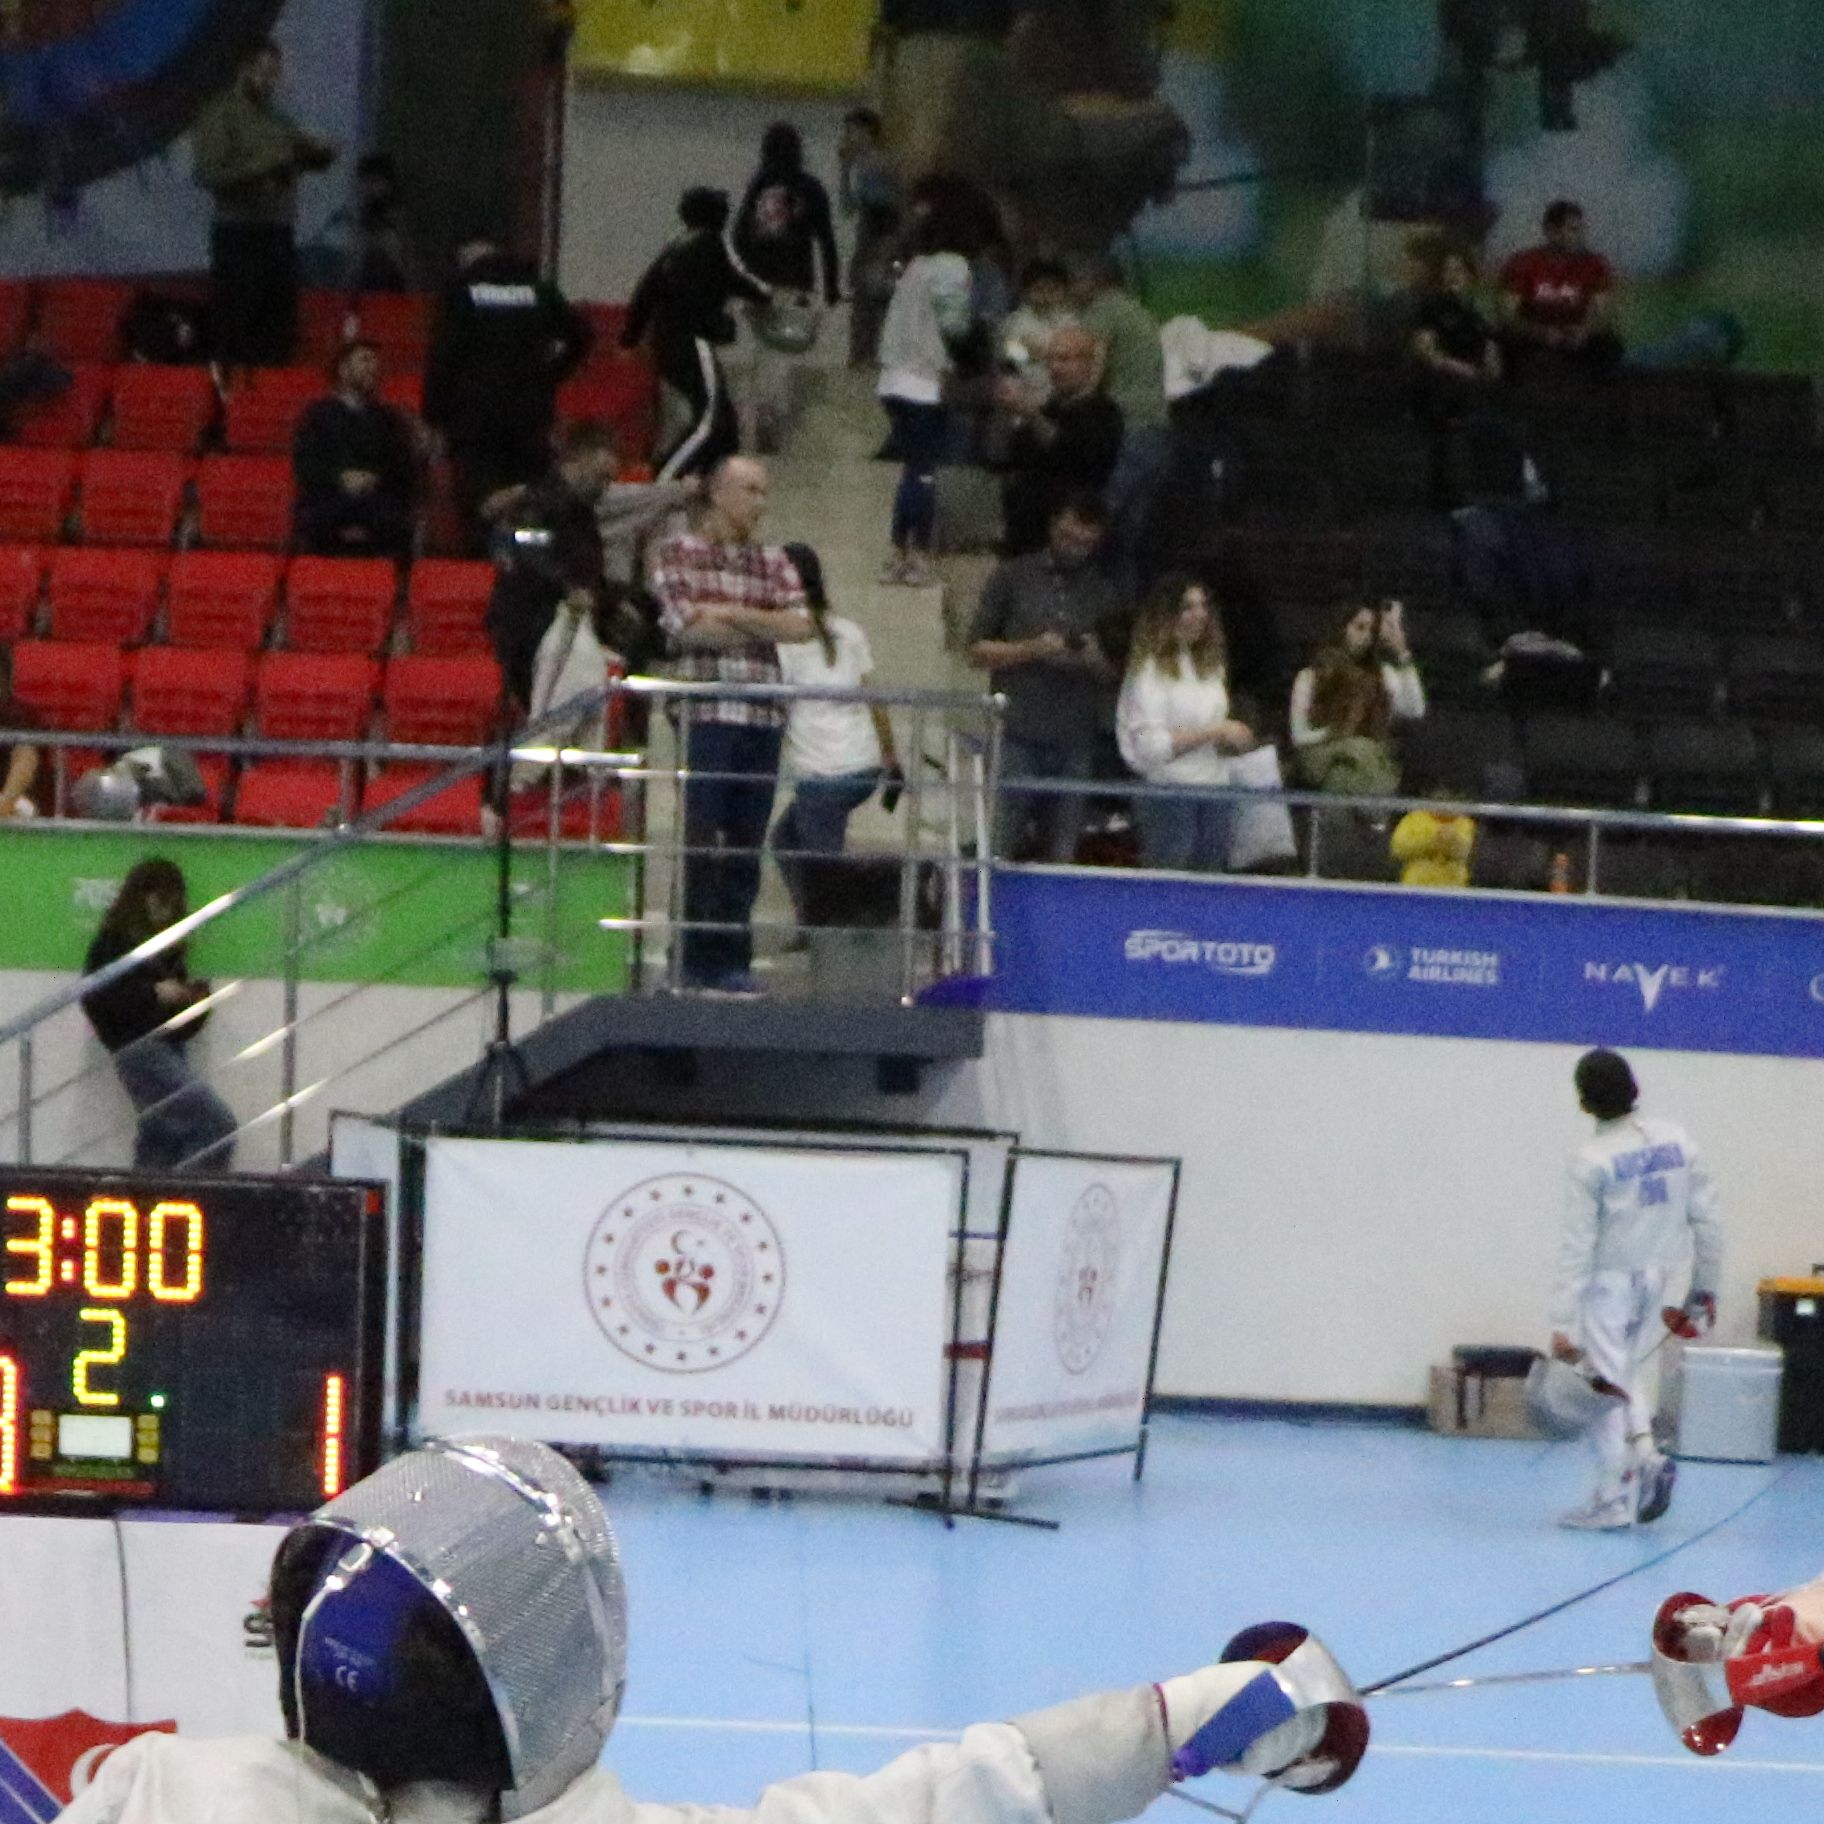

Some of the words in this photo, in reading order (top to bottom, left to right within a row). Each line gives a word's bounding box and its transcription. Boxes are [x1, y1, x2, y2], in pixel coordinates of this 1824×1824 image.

[1409, 946, 1498, 968] TURKISH
[4, 1196, 203, 1302] 3:00
[444, 1388, 541, 1411] SAMSUN
[645, 1397, 675, 1416] VE
[679, 1399, 738, 1419] SPOR
[767, 1400, 915, 1429] MÜDÜRLÜĞÜ
[324, 1374, 344, 1497] 1
[335, 1665, 360, 1692] CE
